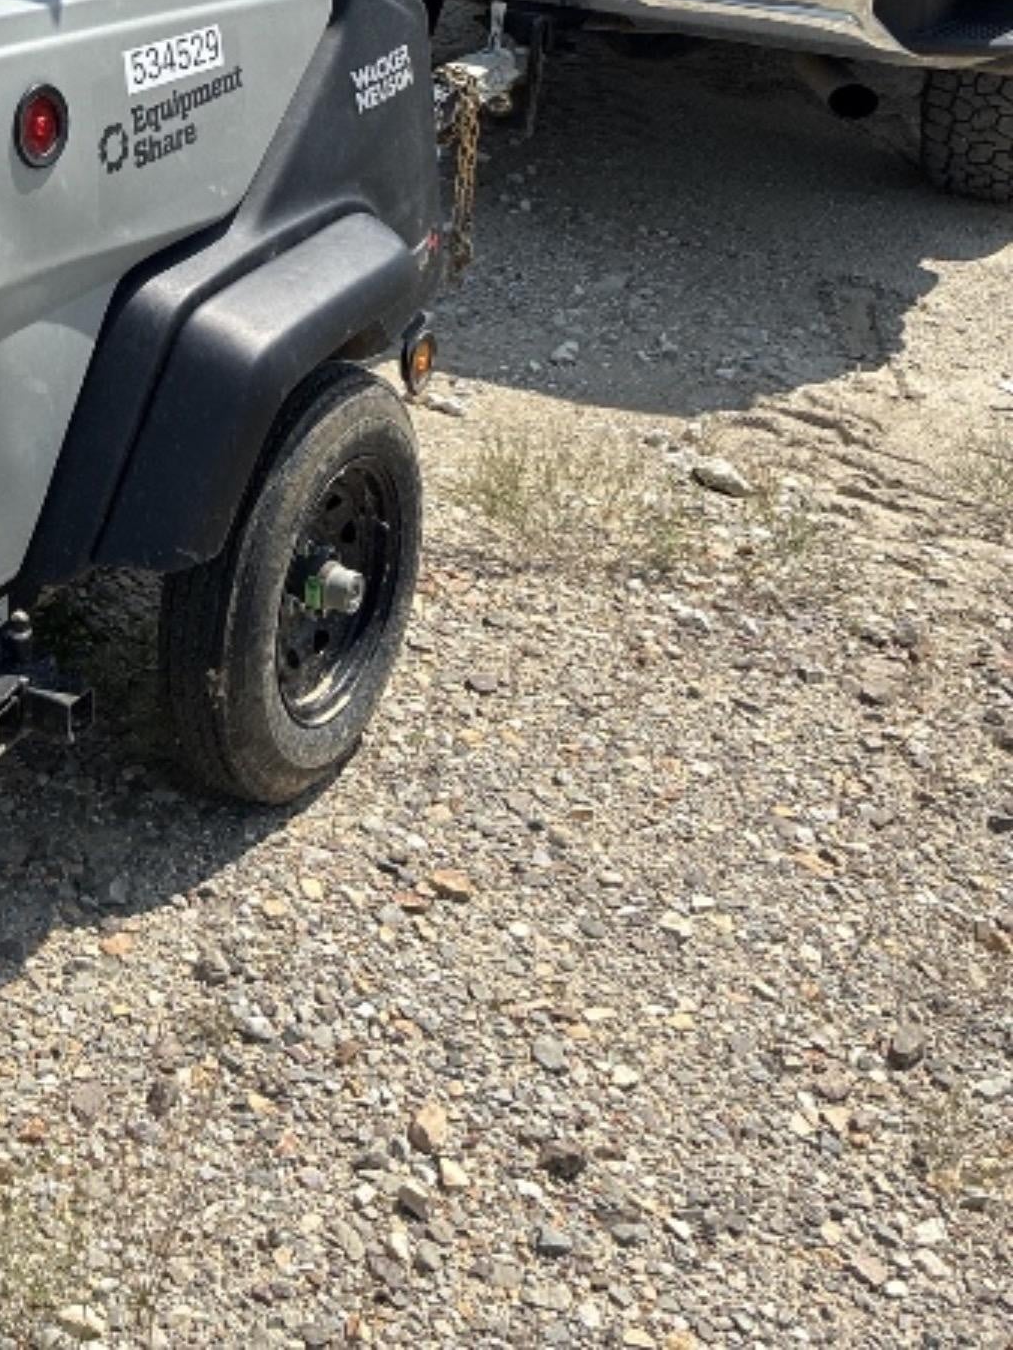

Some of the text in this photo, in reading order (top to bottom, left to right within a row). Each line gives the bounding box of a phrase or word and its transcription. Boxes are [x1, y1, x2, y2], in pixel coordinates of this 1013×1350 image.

[131, 29, 219, 85] 534529
[349, 44, 411, 90] WACKER
[131, 66, 243, 135] Equipment
[355, 68, 414, 115] NEUSON
[134, 123, 197, 169] Share
